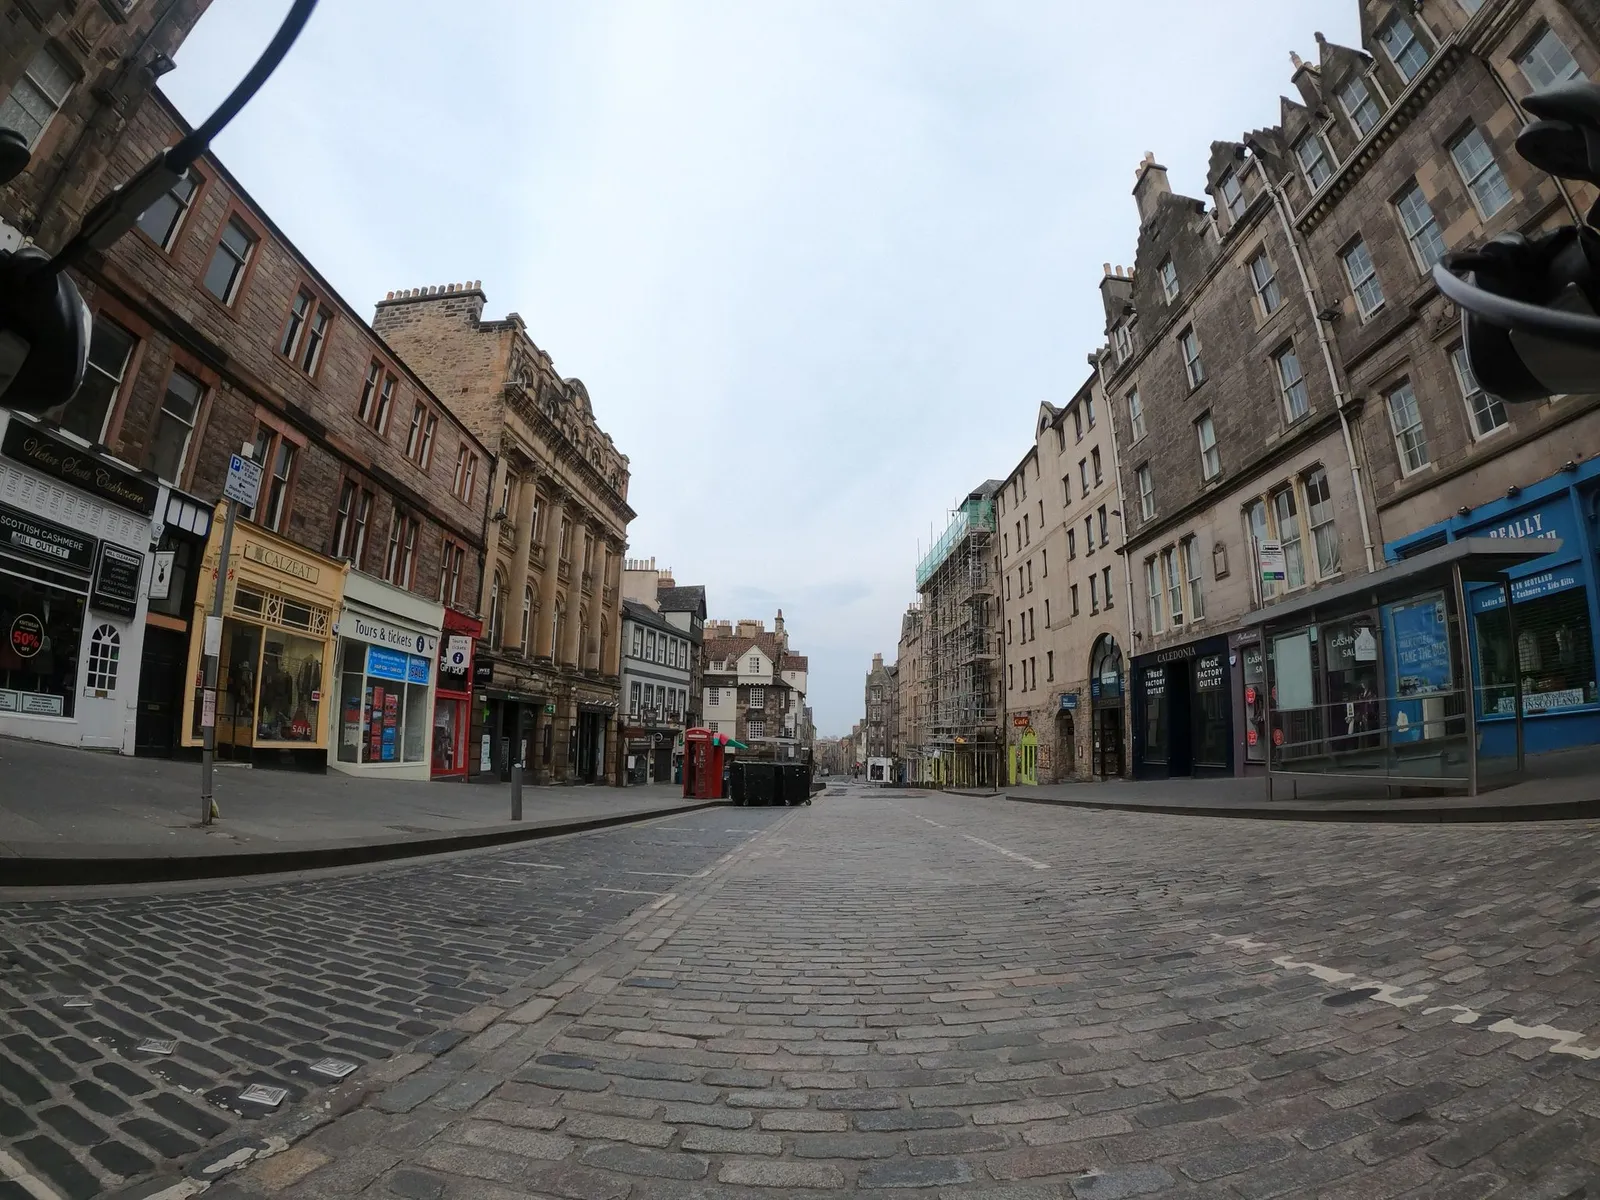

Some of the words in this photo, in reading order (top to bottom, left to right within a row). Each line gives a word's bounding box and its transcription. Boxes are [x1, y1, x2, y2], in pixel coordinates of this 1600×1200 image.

[23, 437, 60, 466] Victor
[62, 456, 92, 481] Scott
[96, 468, 144, 504] Cashmere
[0, 515, 40, 537] SCOTTISH
[41, 530, 84, 552] CASHMERE
[35, 540, 66, 556] OUTLET
[116, 553, 139, 565] CLEARANCE
[264, 551, 312, 579] CALZEAT
[1516, 582, 1523, 590] IN
[1524, 573, 1553, 587] SCOTLAND
[1481, 599, 1498, 608] Ladies
[1516, 587, 1541, 599] Cashmere
[1547, 582, 1560, 590] Kids
[1560, 577, 1575, 587] Kilts
[13, 630, 40, 649] 50%
[355, 619, 378, 639] Tours
[379, 627, 386, 641] &
[388, 630, 412, 648] tickets
[1331, 636, 1355, 648] CASHM
[1157, 646, 1196, 663] CALEDONIA
[1342, 648, 1355, 658] SAL
[1400, 649, 1418, 665] TAKE
[1418, 646, 1431, 660] THE
[1200, 659, 1219, 669] WOOL
[1197, 667, 1223, 678] FACTORY
[1145, 678, 1166, 687] FACTORY
[1147, 686, 1164, 695] OUTLET
[1199, 677, 1222, 688] OUTLET
[1535, 695, 1580, 709] SCOTLAND
